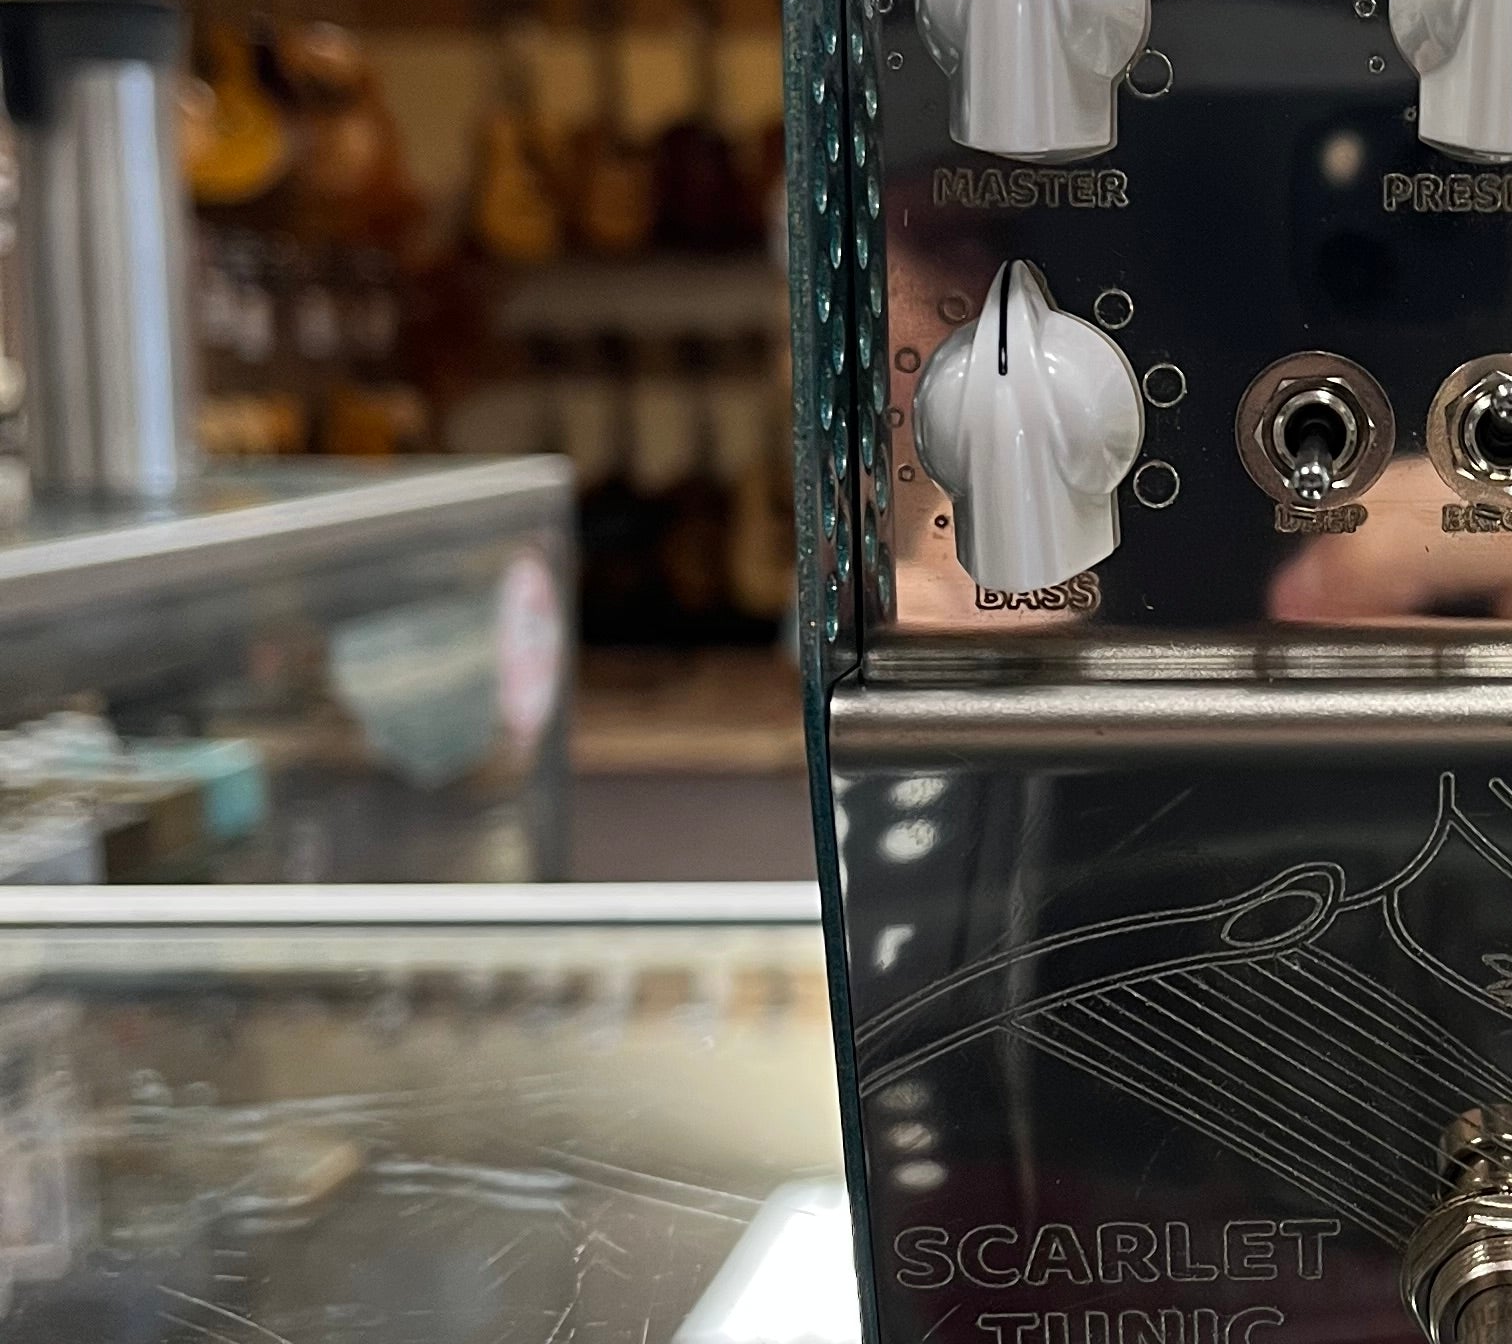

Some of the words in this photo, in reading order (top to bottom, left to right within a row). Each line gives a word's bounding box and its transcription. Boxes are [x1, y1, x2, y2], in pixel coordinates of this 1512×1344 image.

[933, 167, 1129, 208] MASTER
[975, 570, 1100, 611] BASS
[893, 1218, 1341, 1289] SCARLET
